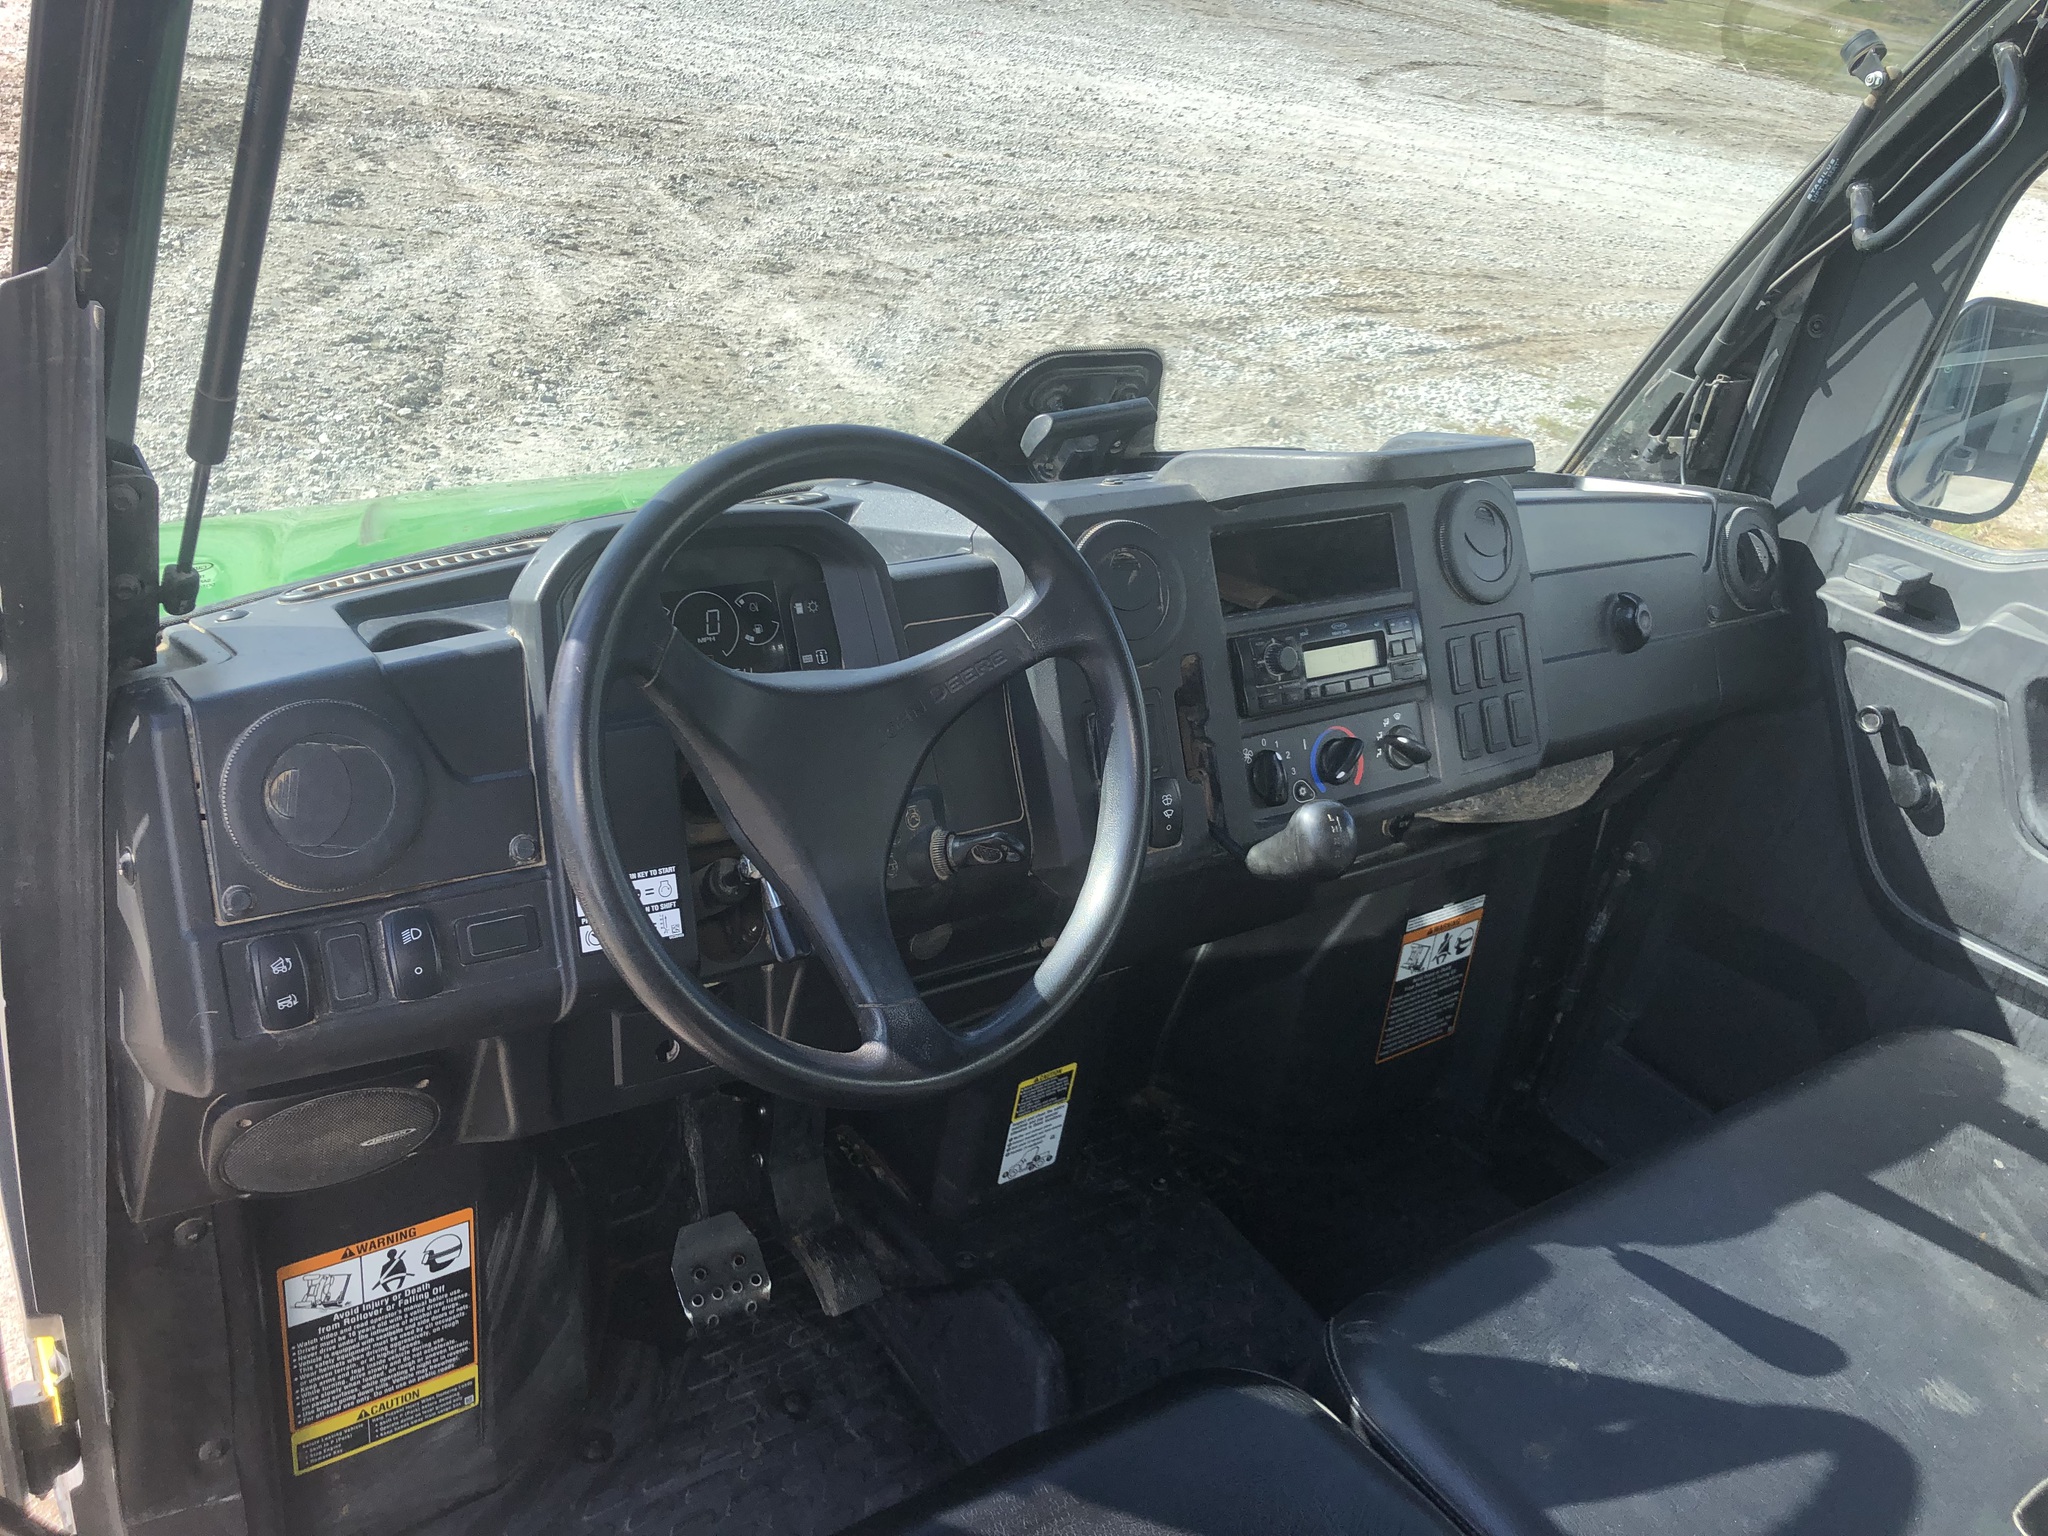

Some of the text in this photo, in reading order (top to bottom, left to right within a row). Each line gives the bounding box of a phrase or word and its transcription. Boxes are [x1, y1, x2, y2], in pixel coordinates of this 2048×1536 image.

[1807, 158, 1836, 200] STABILUS
[706, 609, 720, 636] 0
[929, 649, 1008, 704] DEERE
[1261, 738, 1296, 775] 0 1 2 3
[658, 866, 676, 874] START
[660, 901, 676, 910] SHIFT
[356, 1226, 416, 1255] WARNING
[318, 1284, 444, 1335] from Rollover or Falling Off
[332, 1281, 430, 1321] Avoid Injury or Death
[296, 1337, 318, 1349] Watch
[319, 1331, 337, 1341] video
[339, 1325, 351, 1334] and
[353, 1319, 368, 1330] read
[370, 1309, 401, 1324] operator's
[403, 1299, 426, 1312] manual
[428, 1293, 447, 1303] before
[297, 1345, 318, 1356] Driver
[319, 1337, 336, 1348] must
[357, 1324, 375, 1335] years
[377, 1319, 387, 1328] old
[389, 1314, 402, 1324] with
[409, 1306, 425, 1316] valid
[426, 1300, 444, 1310] driver
[370, 1388, 419, 1415] CAUTION
